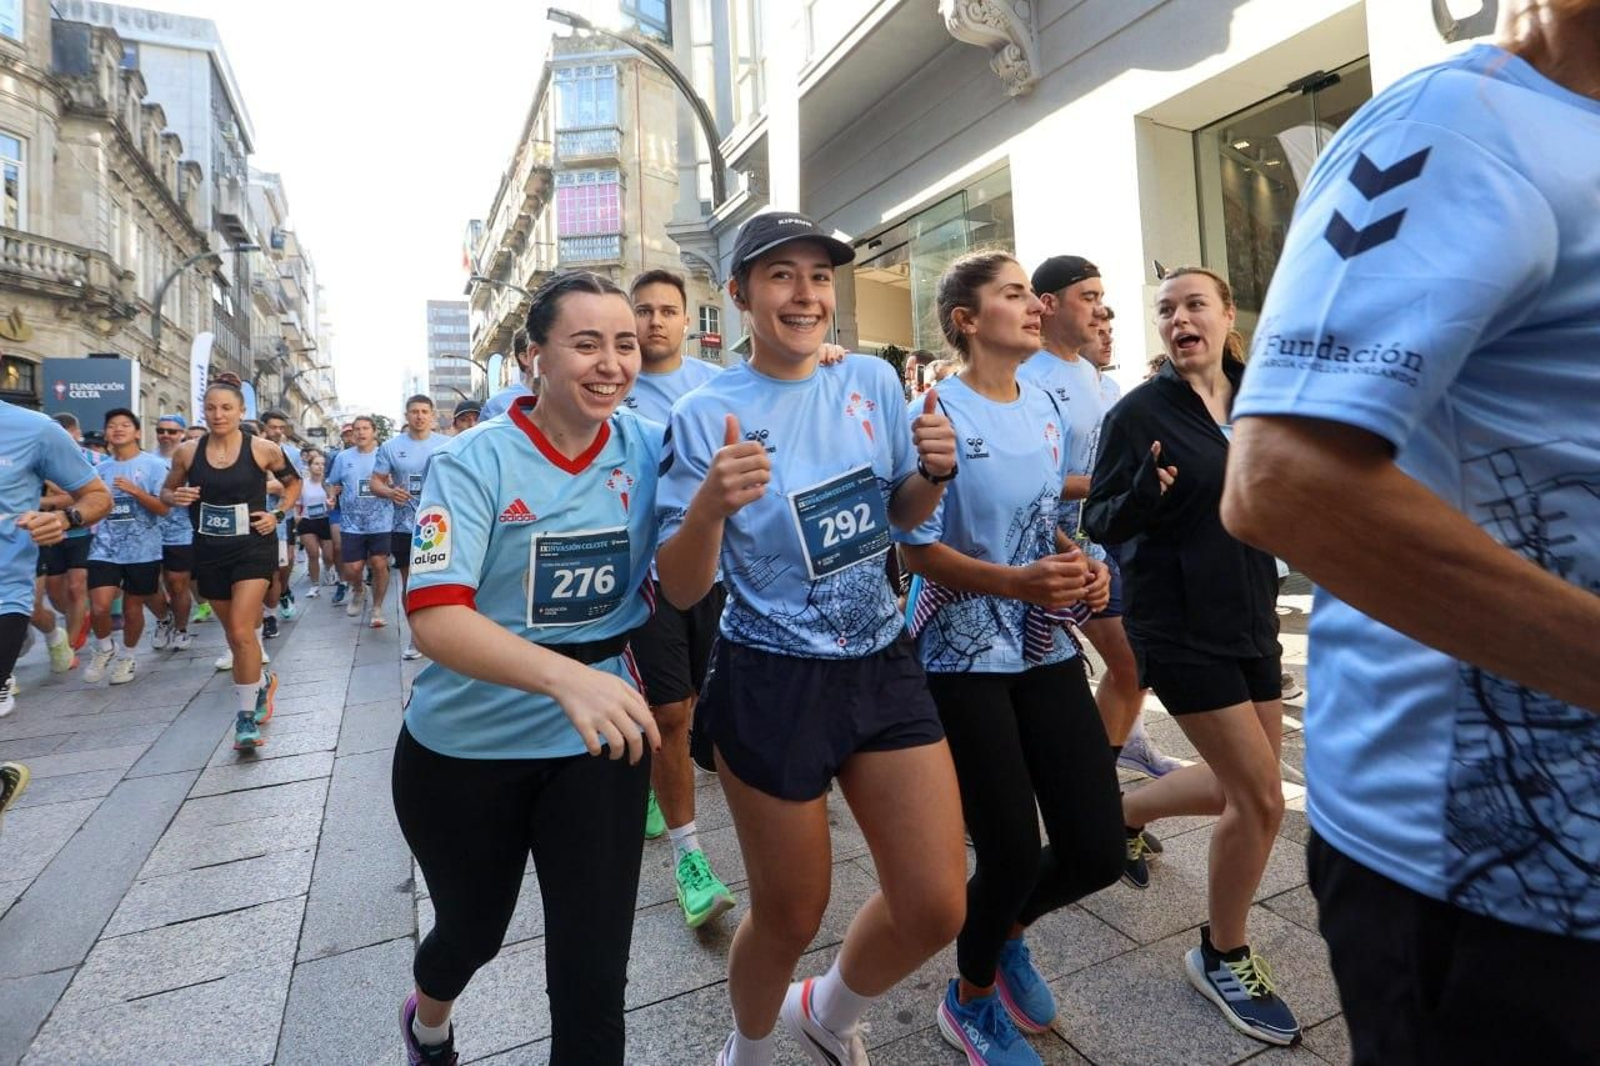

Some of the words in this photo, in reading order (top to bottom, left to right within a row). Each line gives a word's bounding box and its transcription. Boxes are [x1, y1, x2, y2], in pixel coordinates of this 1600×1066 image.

[1263, 335, 1424, 372] Fundación
[69, 382, 125, 391] FUNDACIÓN
[206, 515, 230, 528] 282
[499, 513, 537, 522] adidas
[819, 503, 876, 548] 292
[412, 552, 446, 567] aLiga
[551, 565, 616, 598] 276
[962, 1020, 989, 1055] HOKA
